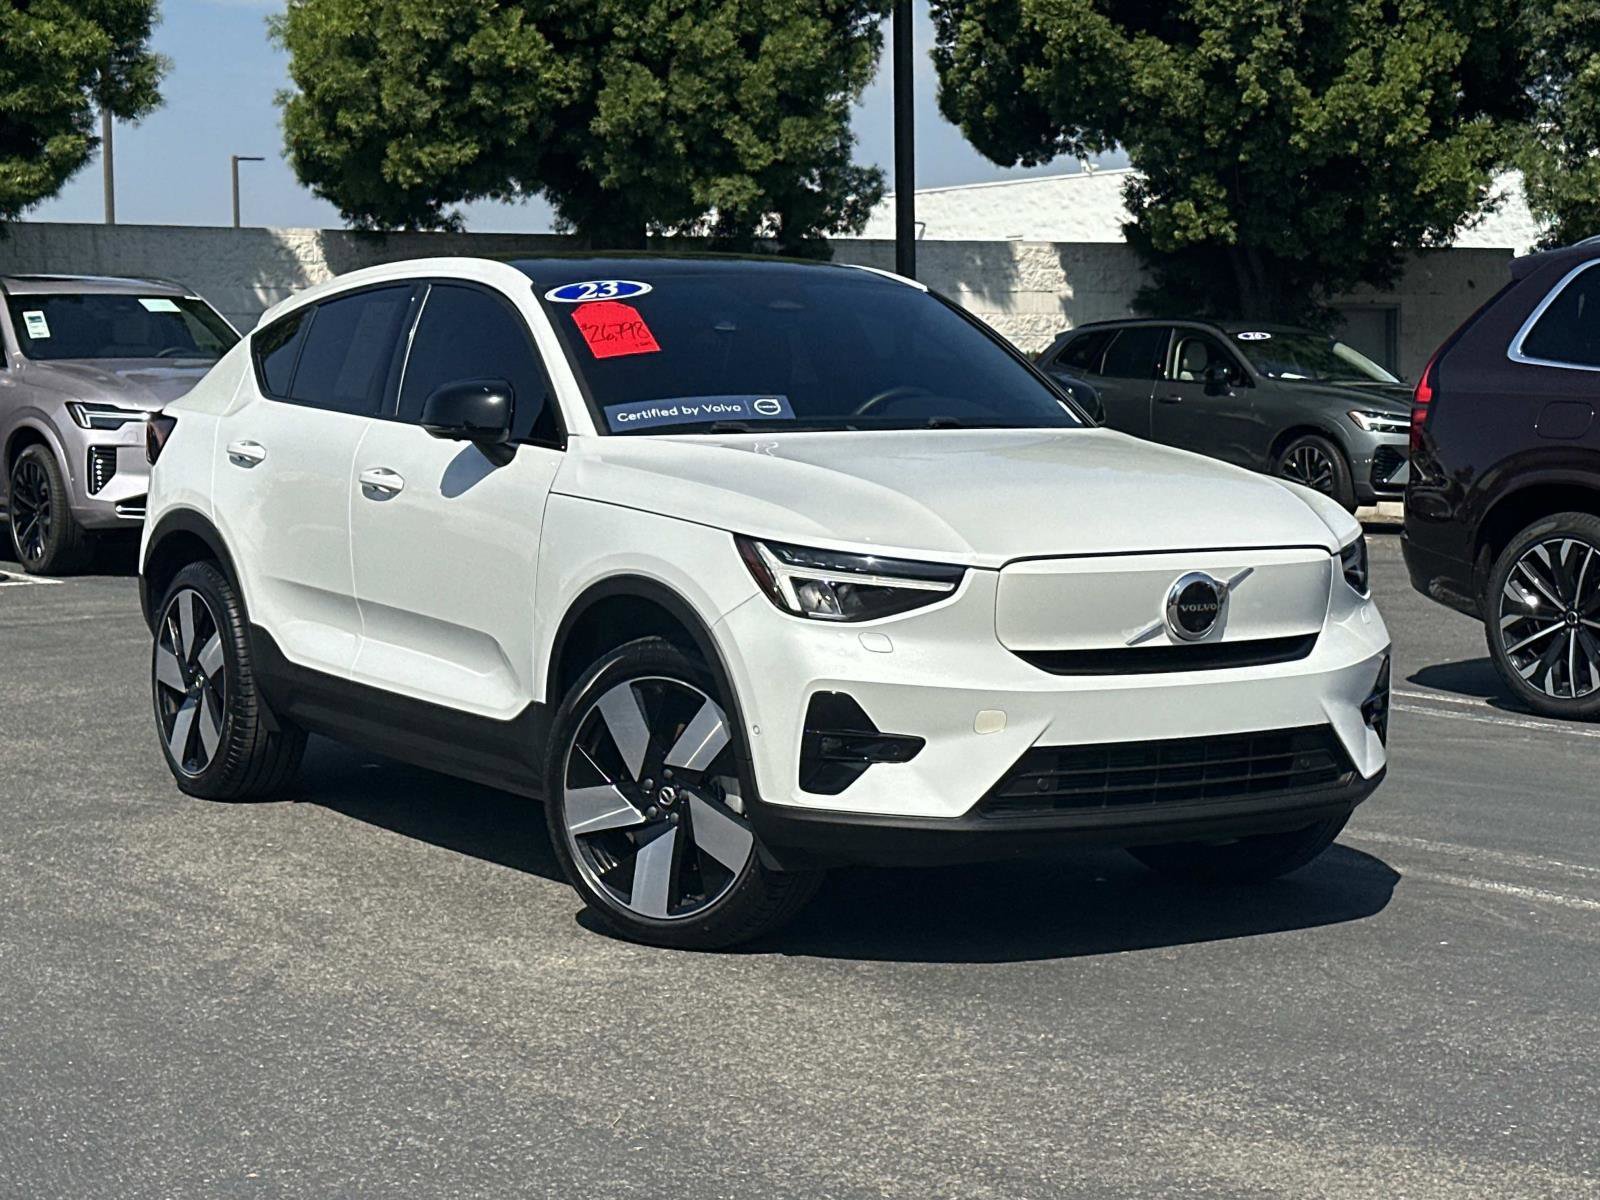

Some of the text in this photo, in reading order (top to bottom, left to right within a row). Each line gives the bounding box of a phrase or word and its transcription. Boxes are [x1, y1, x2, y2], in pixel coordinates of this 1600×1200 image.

[577, 282, 618, 299] 23
[617, 403, 742, 422] Certified by Volvo
[1180, 602, 1218, 612] VOLVO
